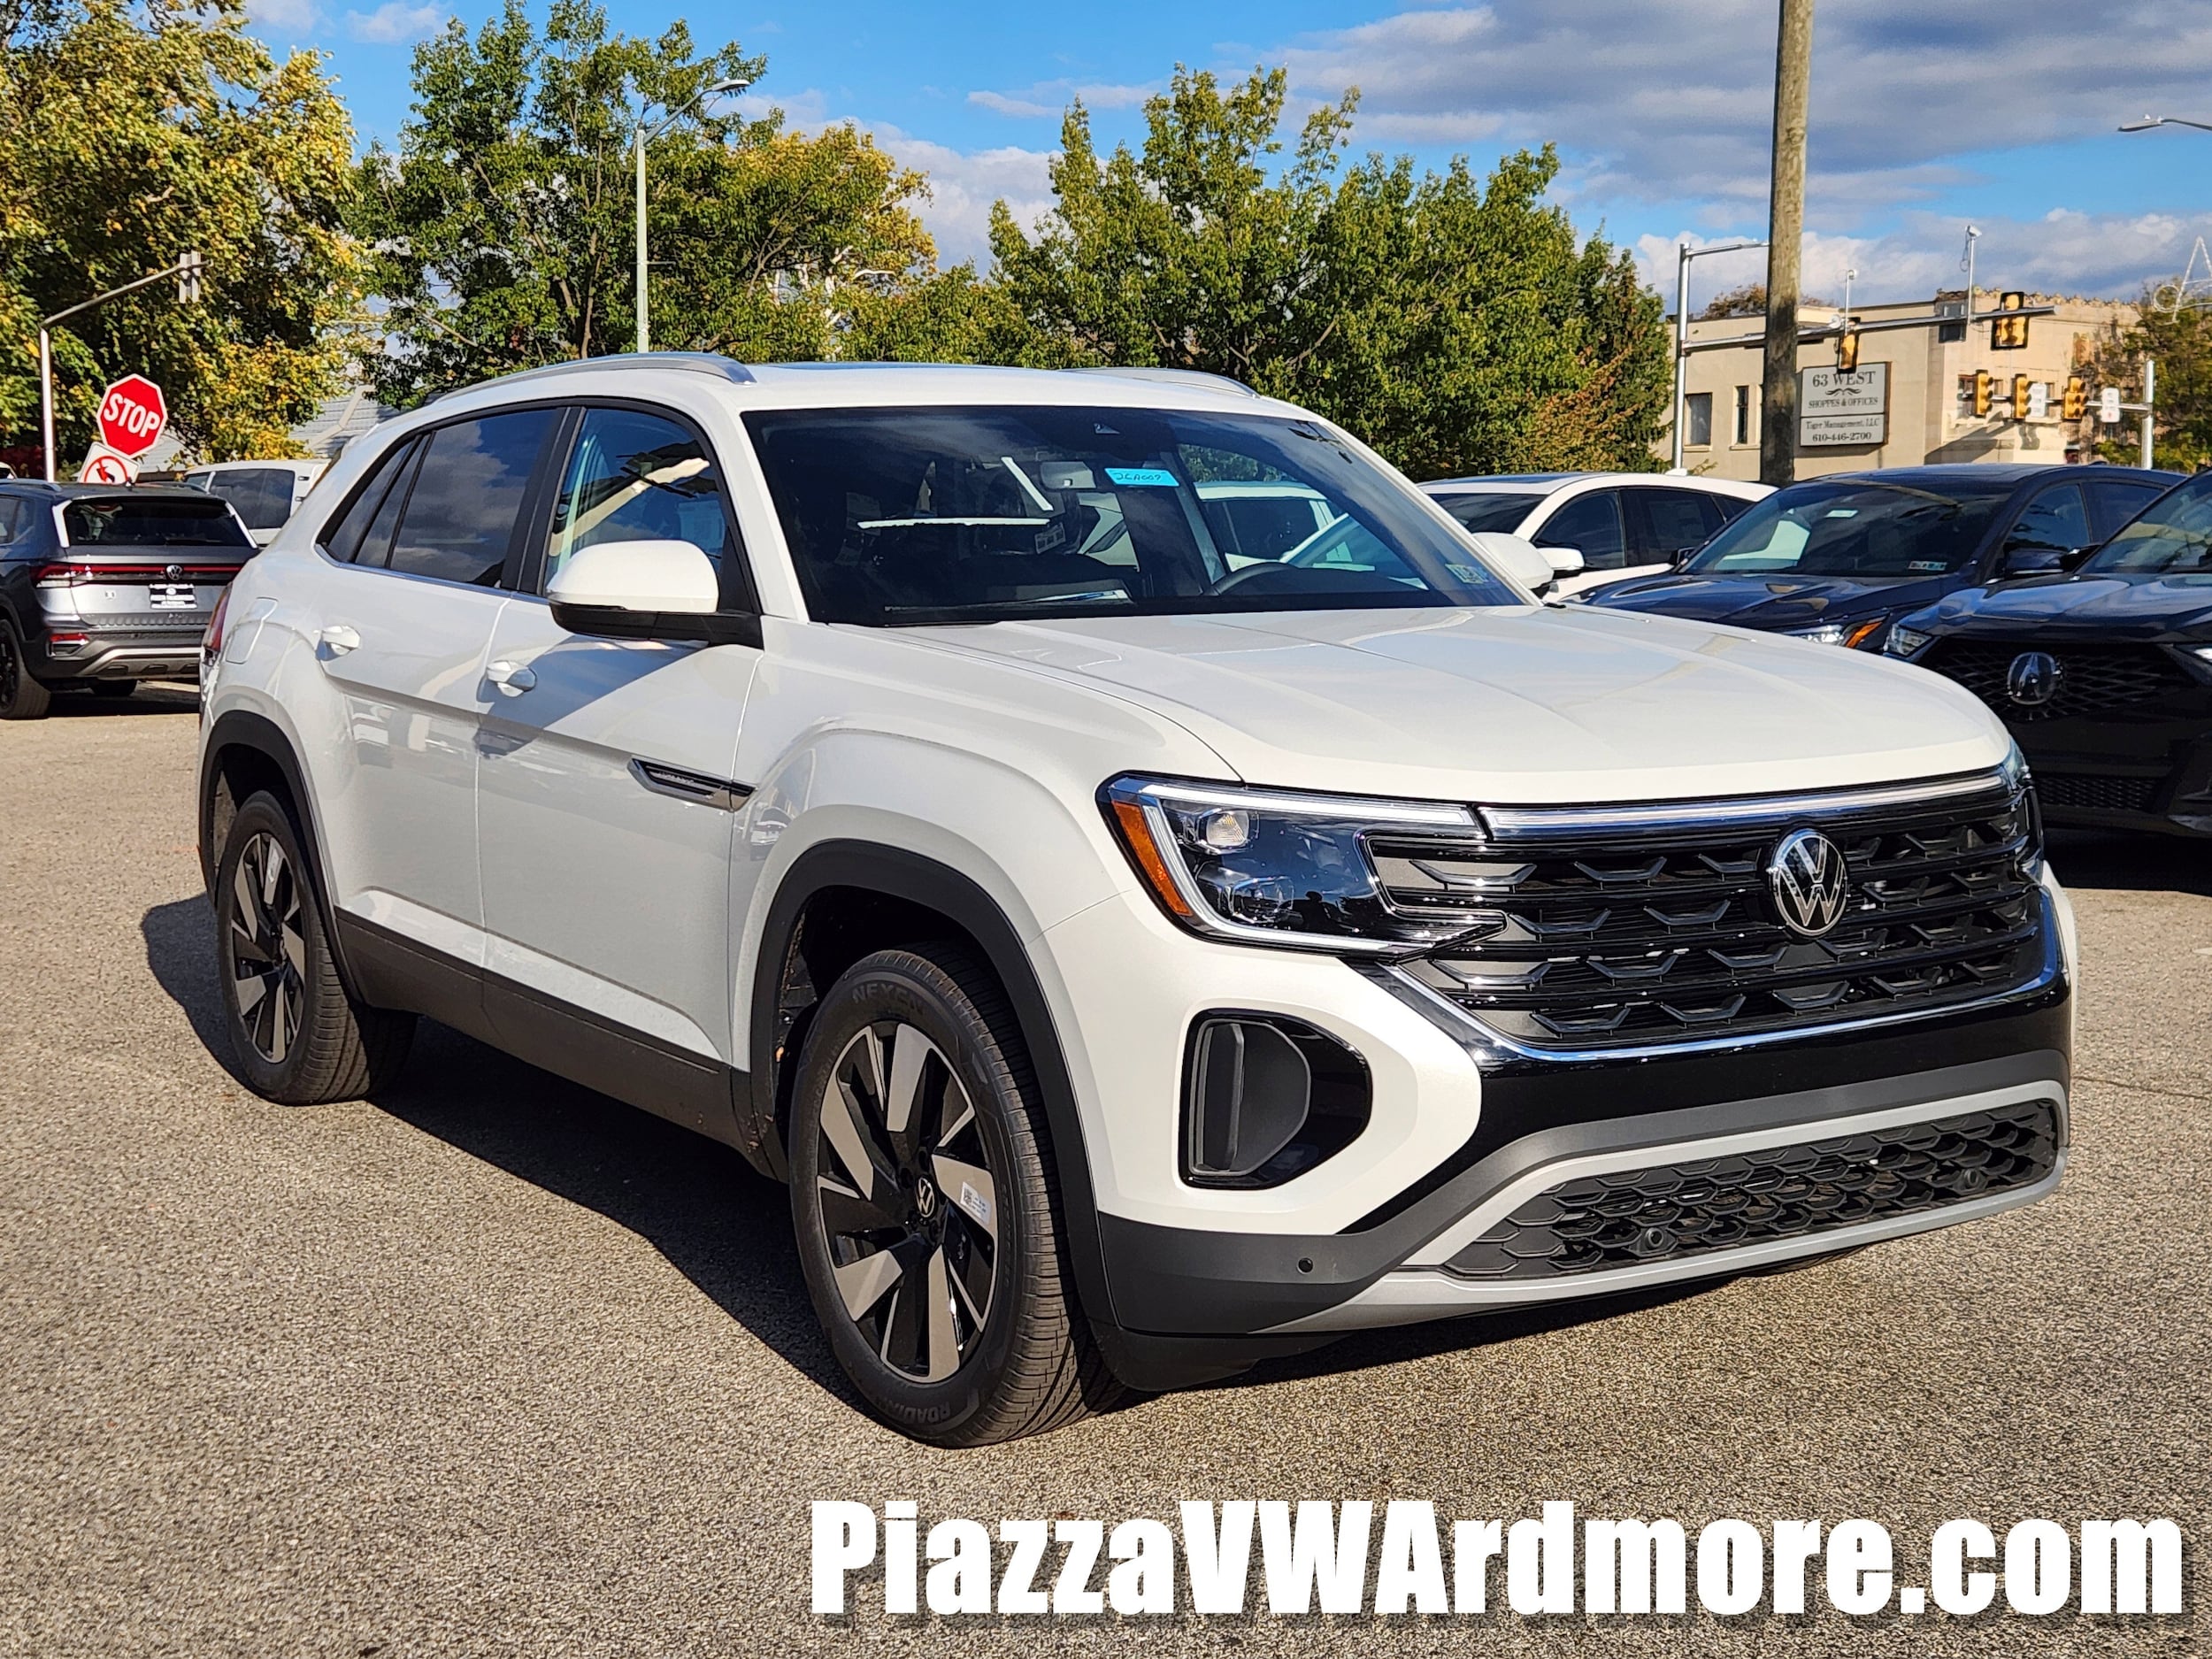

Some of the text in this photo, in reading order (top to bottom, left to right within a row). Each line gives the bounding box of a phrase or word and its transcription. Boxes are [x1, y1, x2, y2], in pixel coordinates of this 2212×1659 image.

[1812, 370, 1876, 388] 63 WEST
[1808, 398, 1839, 409] SHOPPES
[1847, 396, 1878, 407] OFFICES
[104, 393, 160, 438] STOP
